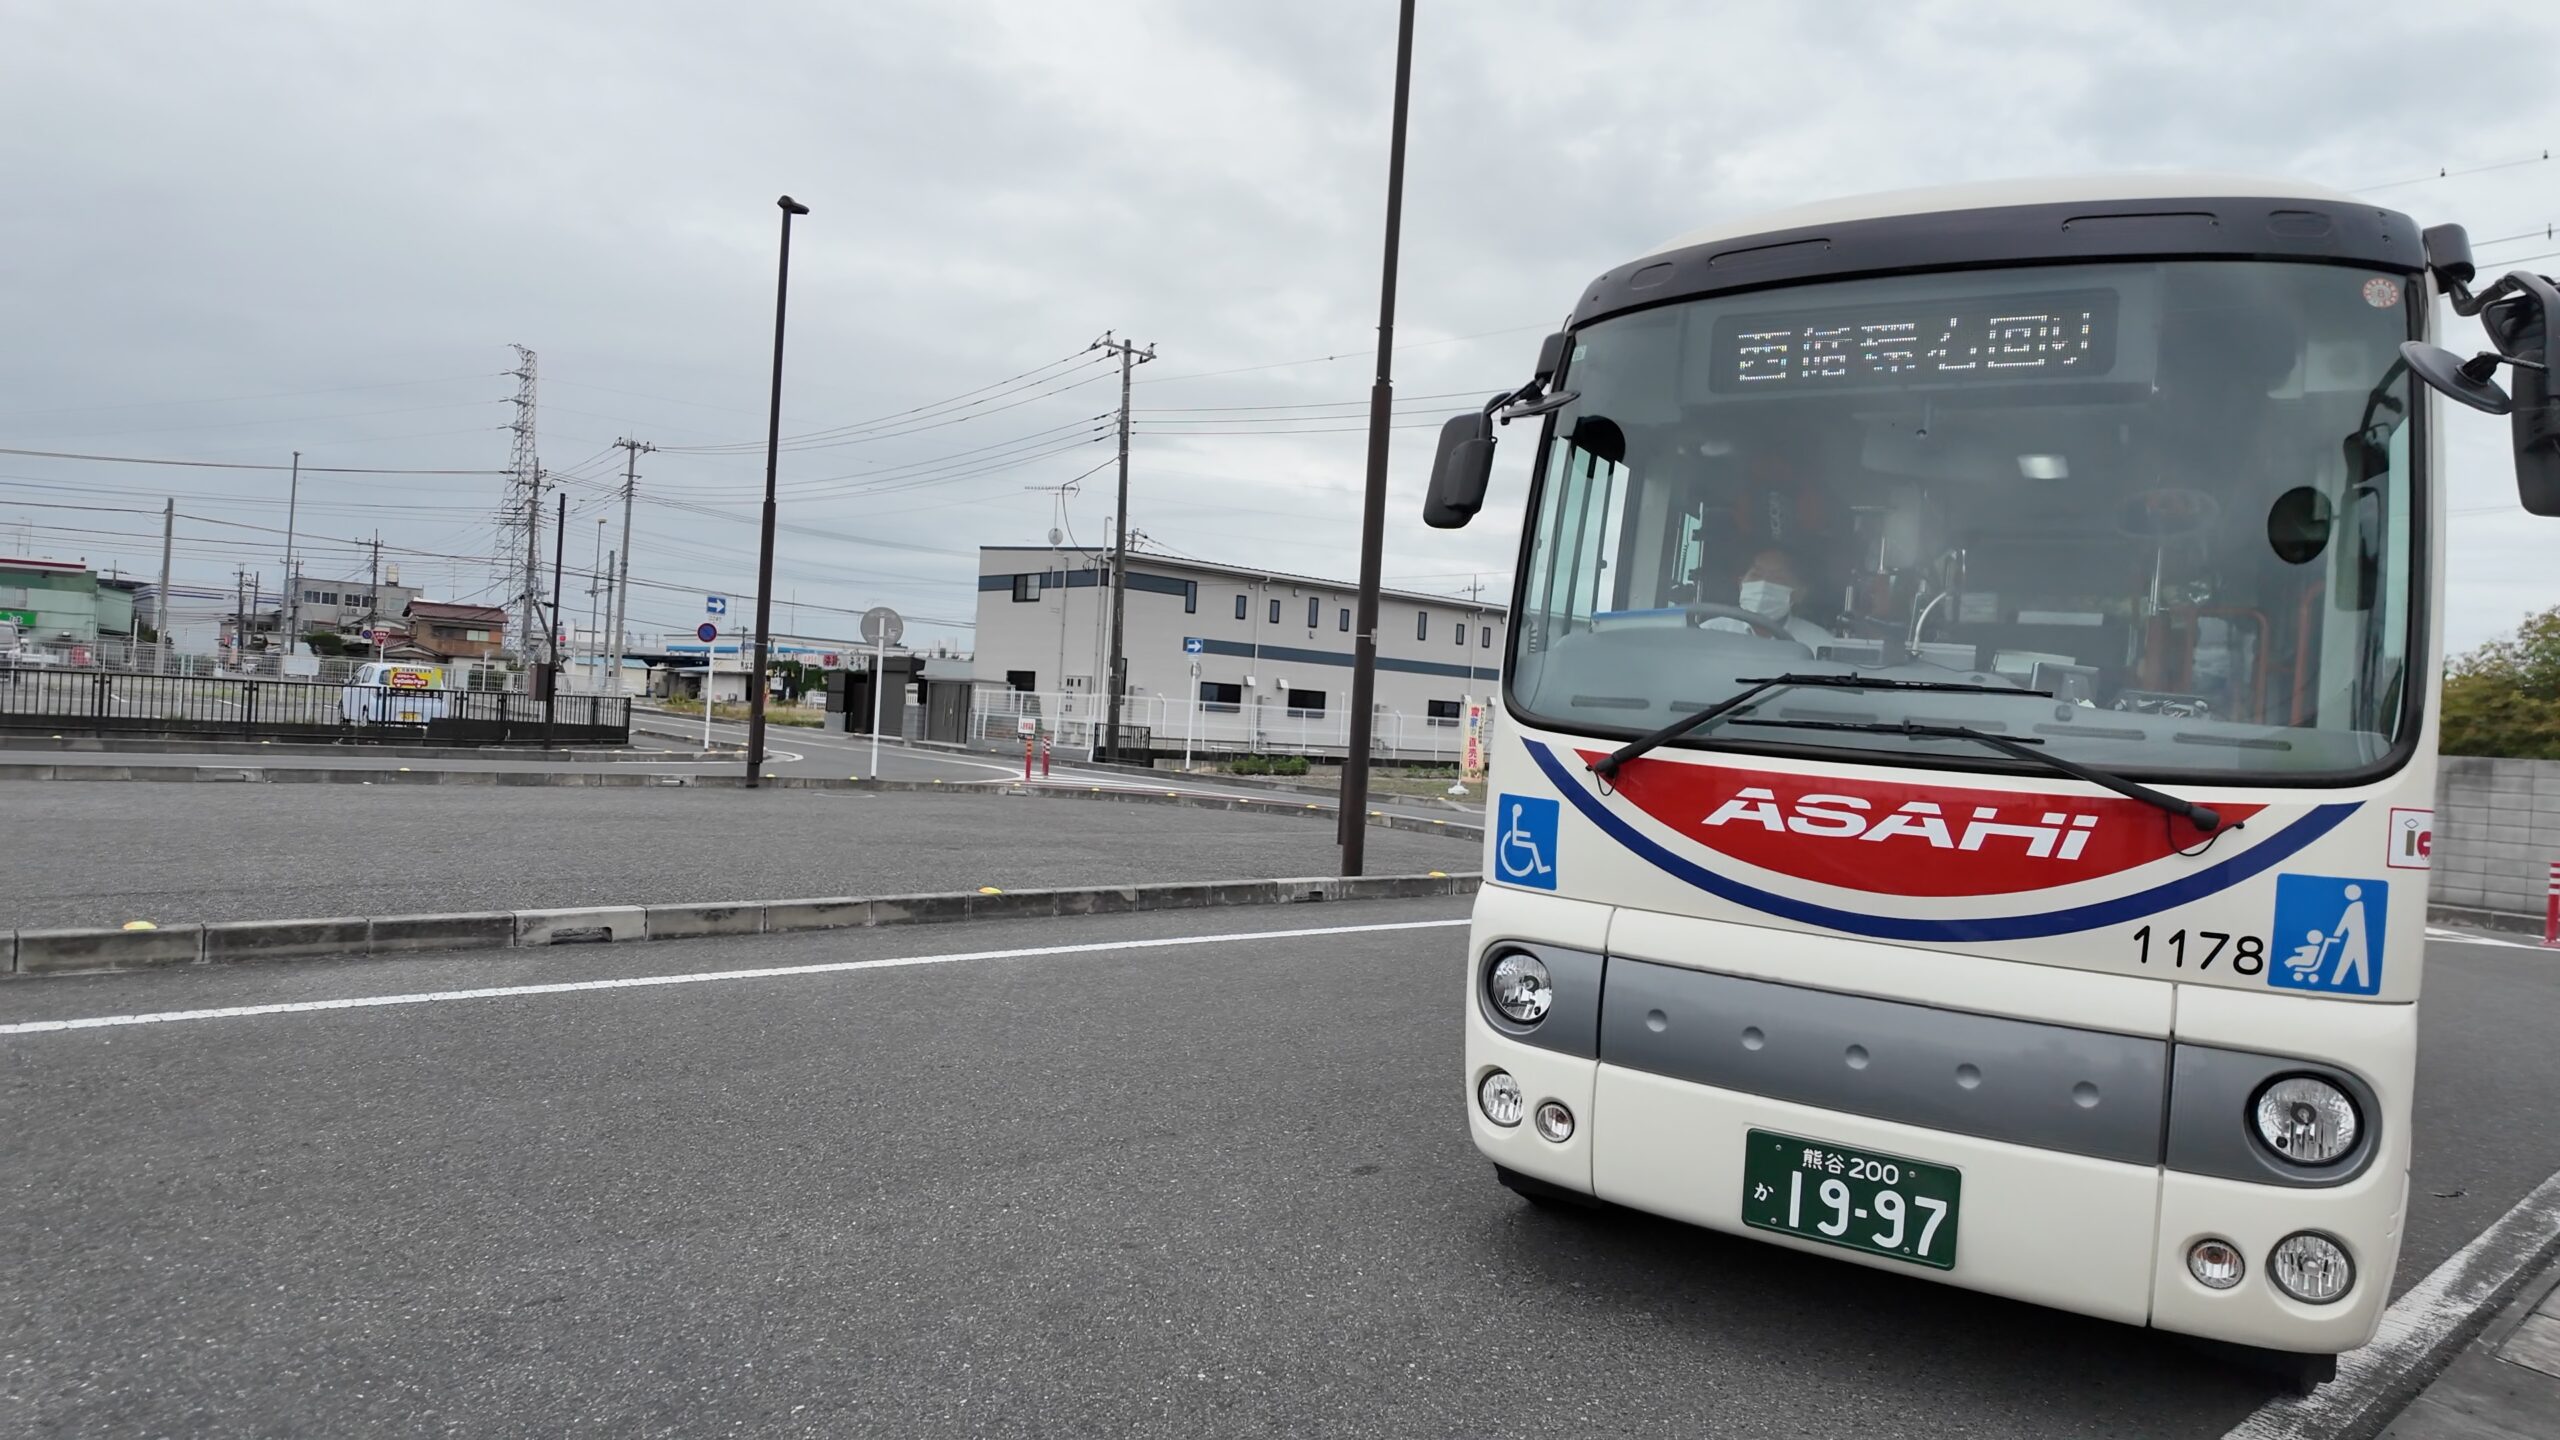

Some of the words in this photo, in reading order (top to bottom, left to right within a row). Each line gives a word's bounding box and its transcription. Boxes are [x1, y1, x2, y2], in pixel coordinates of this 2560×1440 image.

[2133, 925, 2265, 976] 1178
[1753, 1181, 1775, 1202] か
[1788, 1170, 1948, 1257] 19-97
